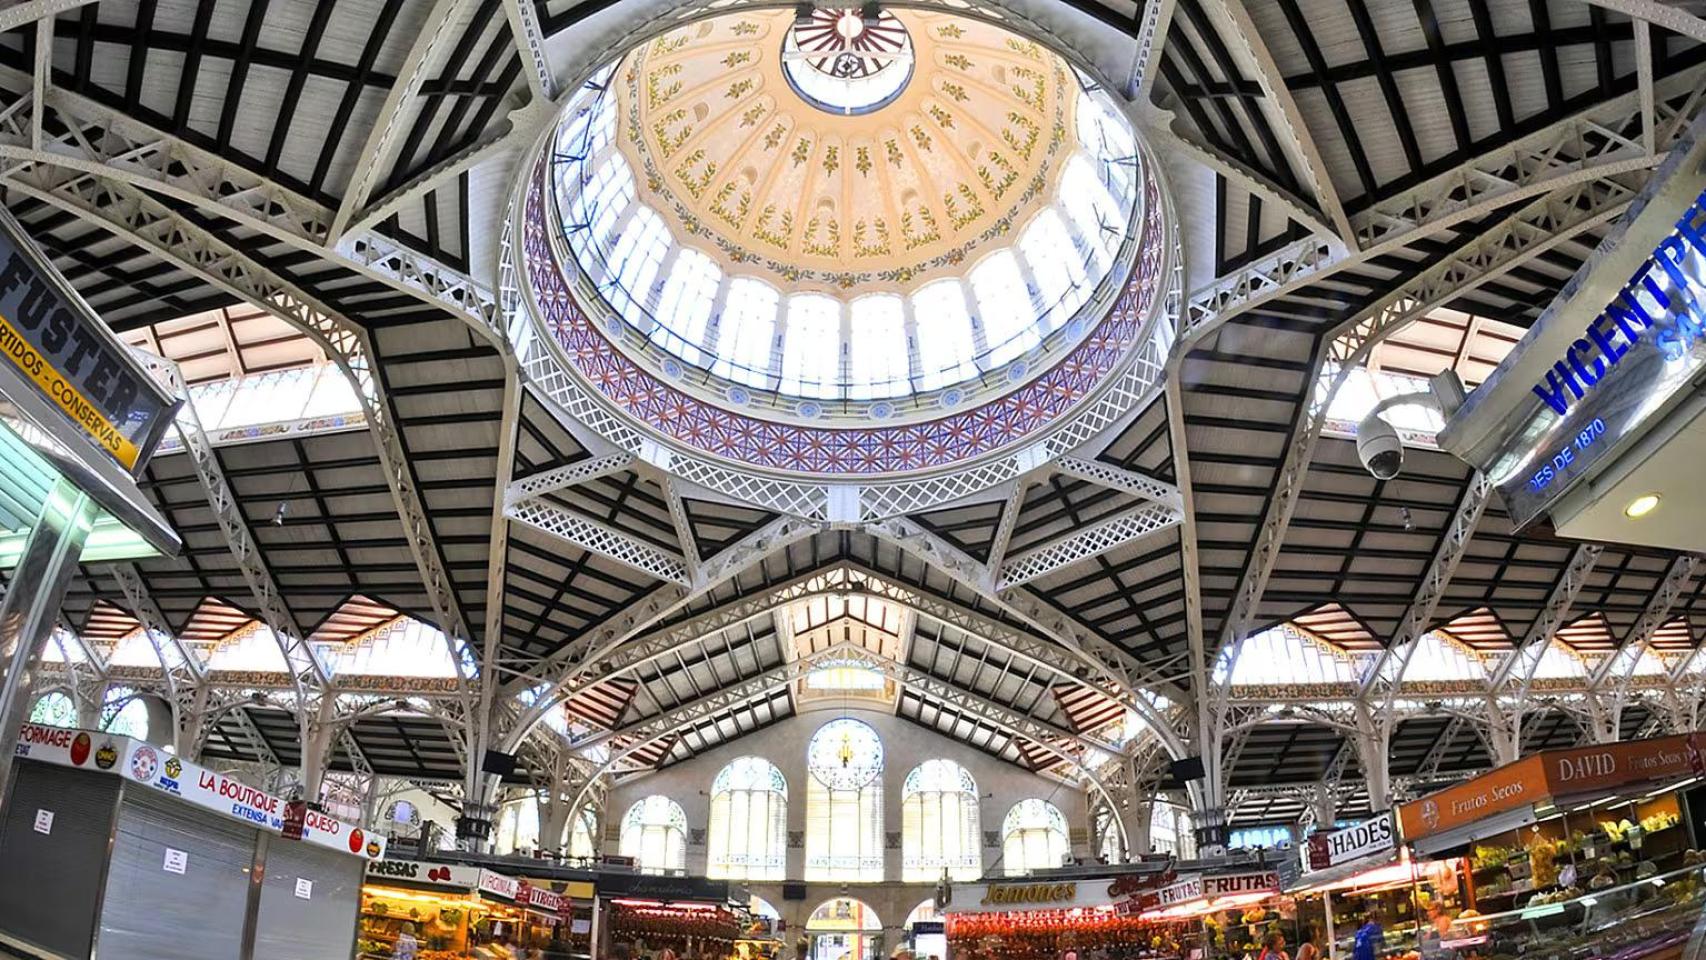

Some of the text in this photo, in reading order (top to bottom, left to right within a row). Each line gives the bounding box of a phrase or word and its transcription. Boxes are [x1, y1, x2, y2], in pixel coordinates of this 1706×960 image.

[1532, 188, 1706, 416] VICENT PE
[0, 252, 138, 428] FUSTER
[0, 318, 43, 376] RTIDOS
[51, 380, 122, 450] CONSERVAS
[1553, 446, 1575, 471] DE
[1574, 418, 1605, 450] 1870
[20, 725, 72, 749] FORMAGE
[1560, 753, 1616, 781] DAVID
[199, 770, 215, 792] LA
[219, 779, 278, 814] BOUTIQUE
[307, 812, 340, 835] QUESO
[1451, 780, 1523, 816] Frutos Secos
[232, 803, 267, 824] EXTENSA
[369, 861, 419, 878] FRESAS
[1203, 873, 1278, 894] FRUTAS
[981, 882, 1077, 906] Jamones
[1162, 880, 1200, 903] FRUTAS
